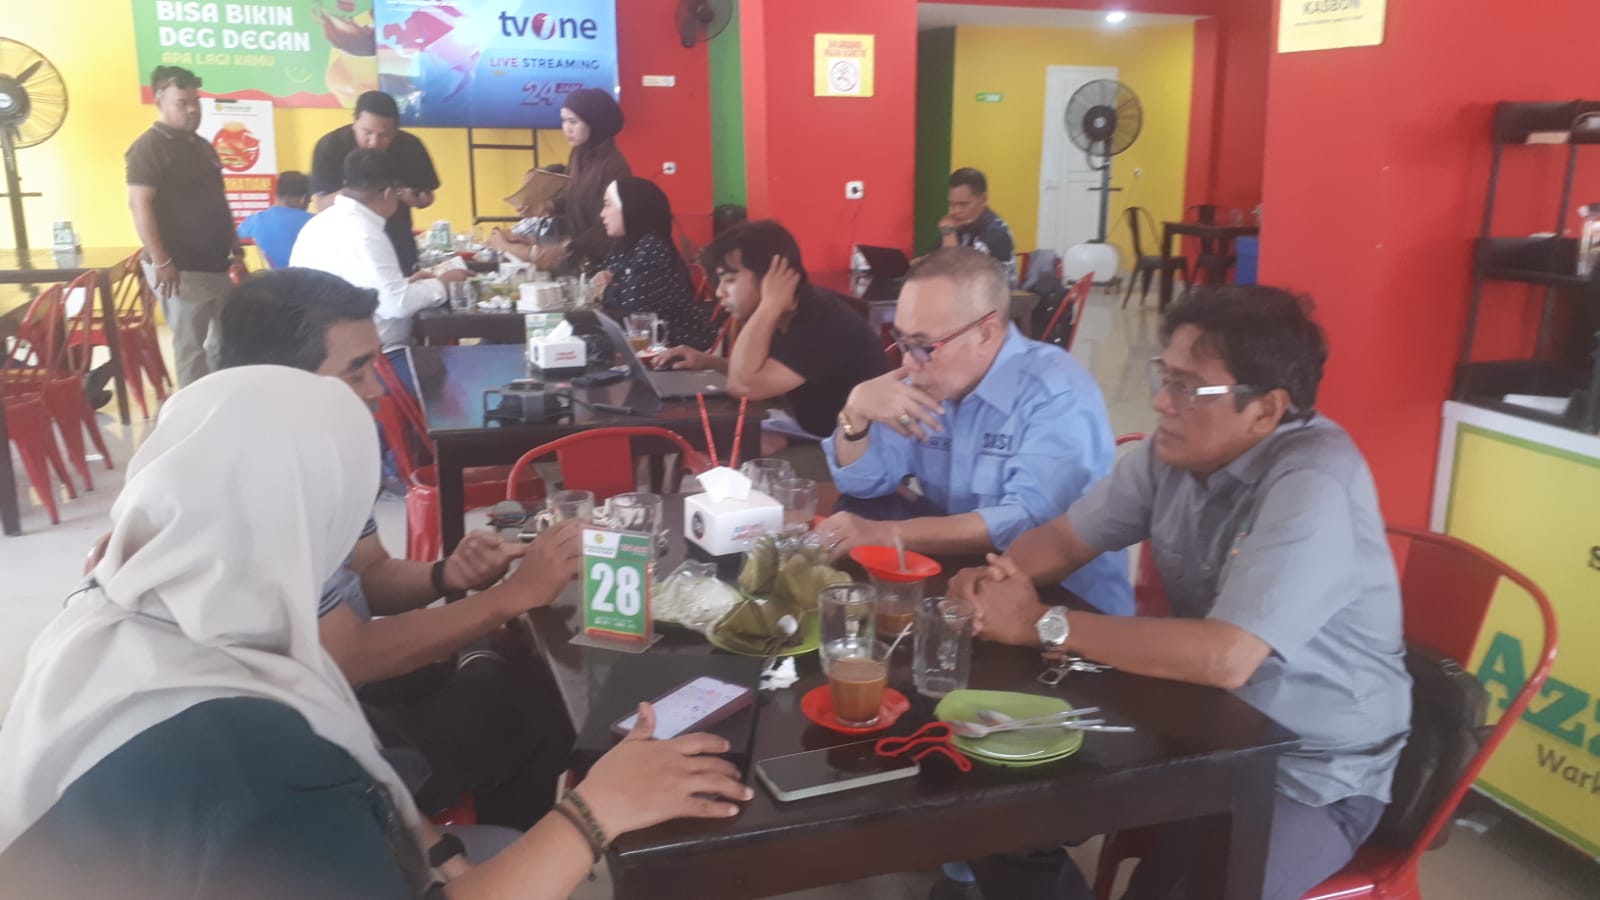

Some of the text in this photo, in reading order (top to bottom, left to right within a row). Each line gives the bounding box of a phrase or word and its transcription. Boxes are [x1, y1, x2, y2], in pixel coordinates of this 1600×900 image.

[156, 0, 294, 26] BISA BIKIN
[158, 26, 311, 51] DEG DEGAN
[161, 52, 276, 67] APA LAGI KAMU
[490, 57, 600, 70] LIVE STREAMING
[590, 562, 642, 617] 28
